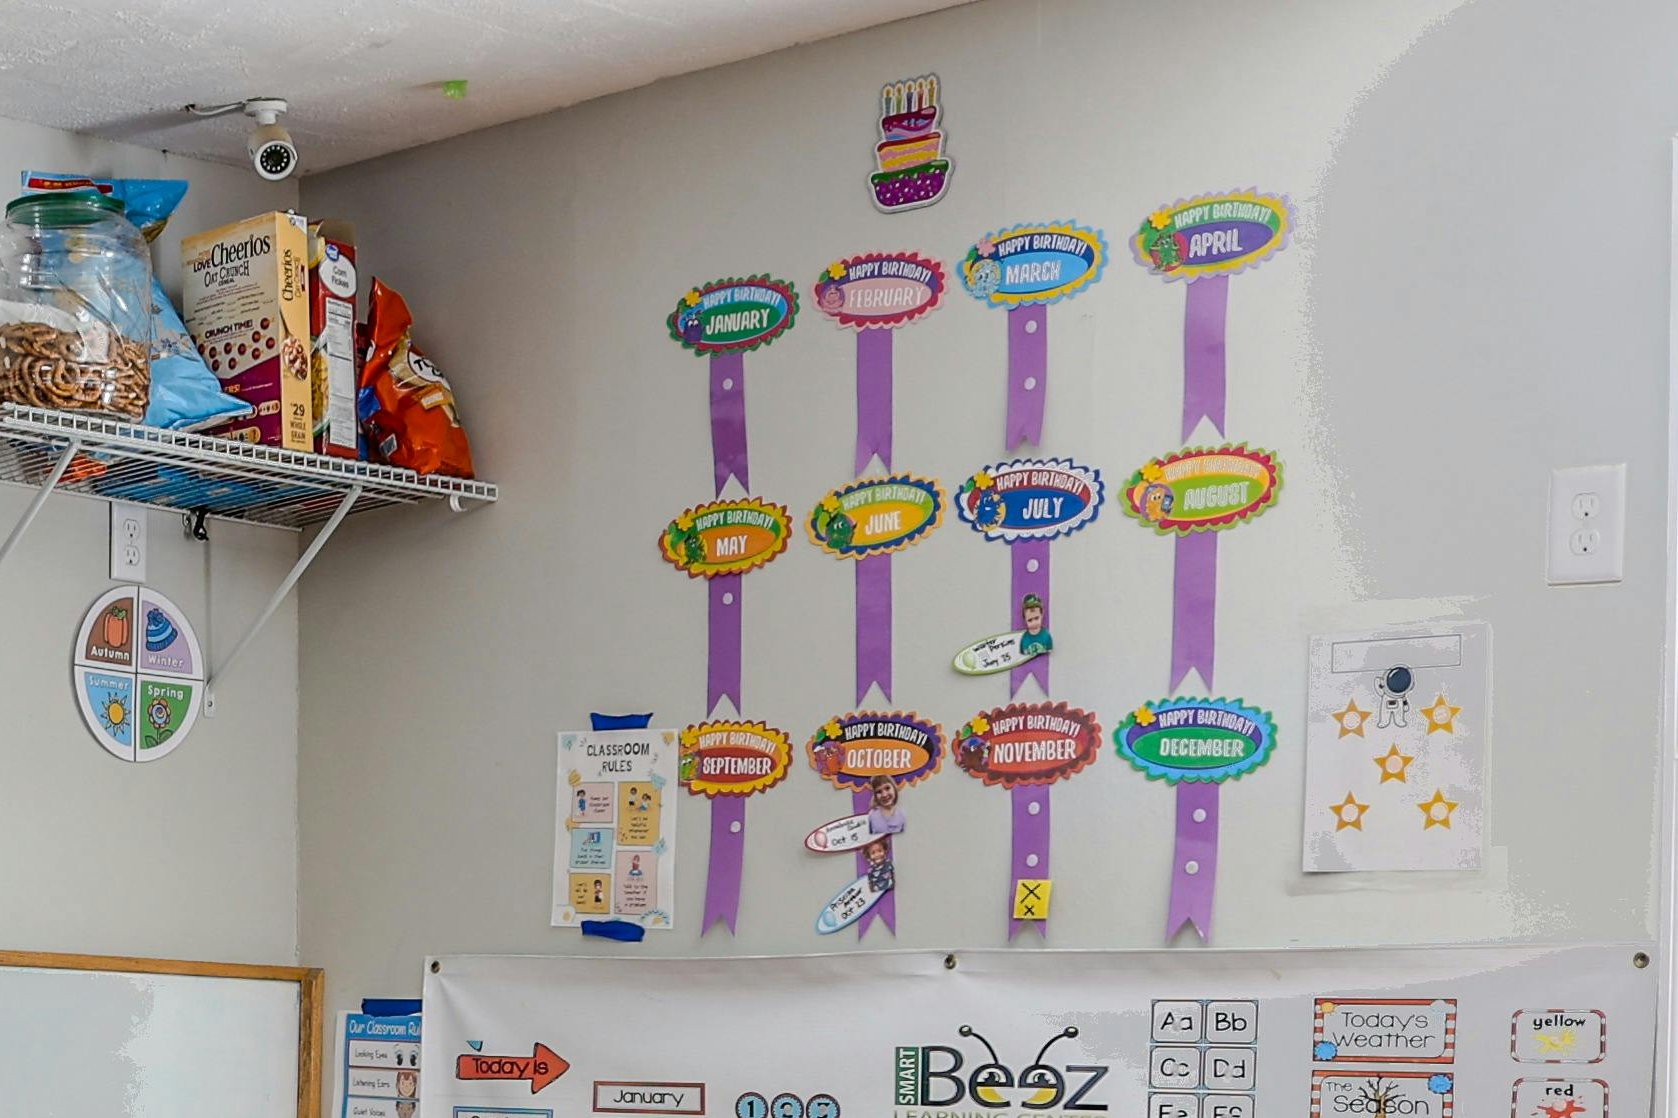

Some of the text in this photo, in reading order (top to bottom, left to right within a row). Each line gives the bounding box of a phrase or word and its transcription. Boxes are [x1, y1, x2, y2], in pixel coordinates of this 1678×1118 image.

[999, 238, 1031, 257] HAPPY
[1190, 228, 1242, 258] APRIL
[194, 259, 211, 272] LOVE
[211, 234, 270, 267] Cheerios
[282, 249, 293, 301] Cheerios
[850, 262, 880, 280] HAPPY
[1006, 260, 1060, 283] MARCH
[849, 288, 923, 307] FEBRUARY
[205, 324, 233, 338] CRUNCH
[707, 309, 770, 335] JANUARY
[293, 404, 304, 416] 29
[997, 473, 1029, 490] HAPPY
[1184, 482, 1249, 510] AUGUST
[1023, 498, 1064, 519] JULY
[866, 511, 901, 534] JUNE
[716, 535, 748, 556] MAY
[91, 646, 129, 660] Autumn
[147, 655, 183, 667] Winter
[89, 675, 129, 690] Summer
[148, 685, 183, 700] Spring
[845, 723, 875, 740] HAPPY
[587, 743, 649, 756] CLASSROOM
[994, 740, 1076, 763] NOVEMBER
[1161, 738, 1244, 757] DECEMBER
[602, 760, 632, 772] RULES
[703, 757, 771, 774] SEPTEMBER
[847, 749, 912, 768] OCTOBER
[350, 1020, 406, 1035] Our Classroom
[1216, 1012, 1247, 1032] Bb
[1342, 1012, 1428, 1031] Today's
[1533, 1015, 1586, 1030] yellow
[1333, 1032, 1436, 1048] Weather
[472, 1057, 529, 1079] Today
[900, 1049, 916, 1104] SMART
[921, 1046, 1108, 1111] Beez
[1326, 1081, 1352, 1092] The
[613, 1088, 684, 1107] January
[1546, 1084, 1573, 1096] red
[1334, 1095, 1429, 1115] Season
